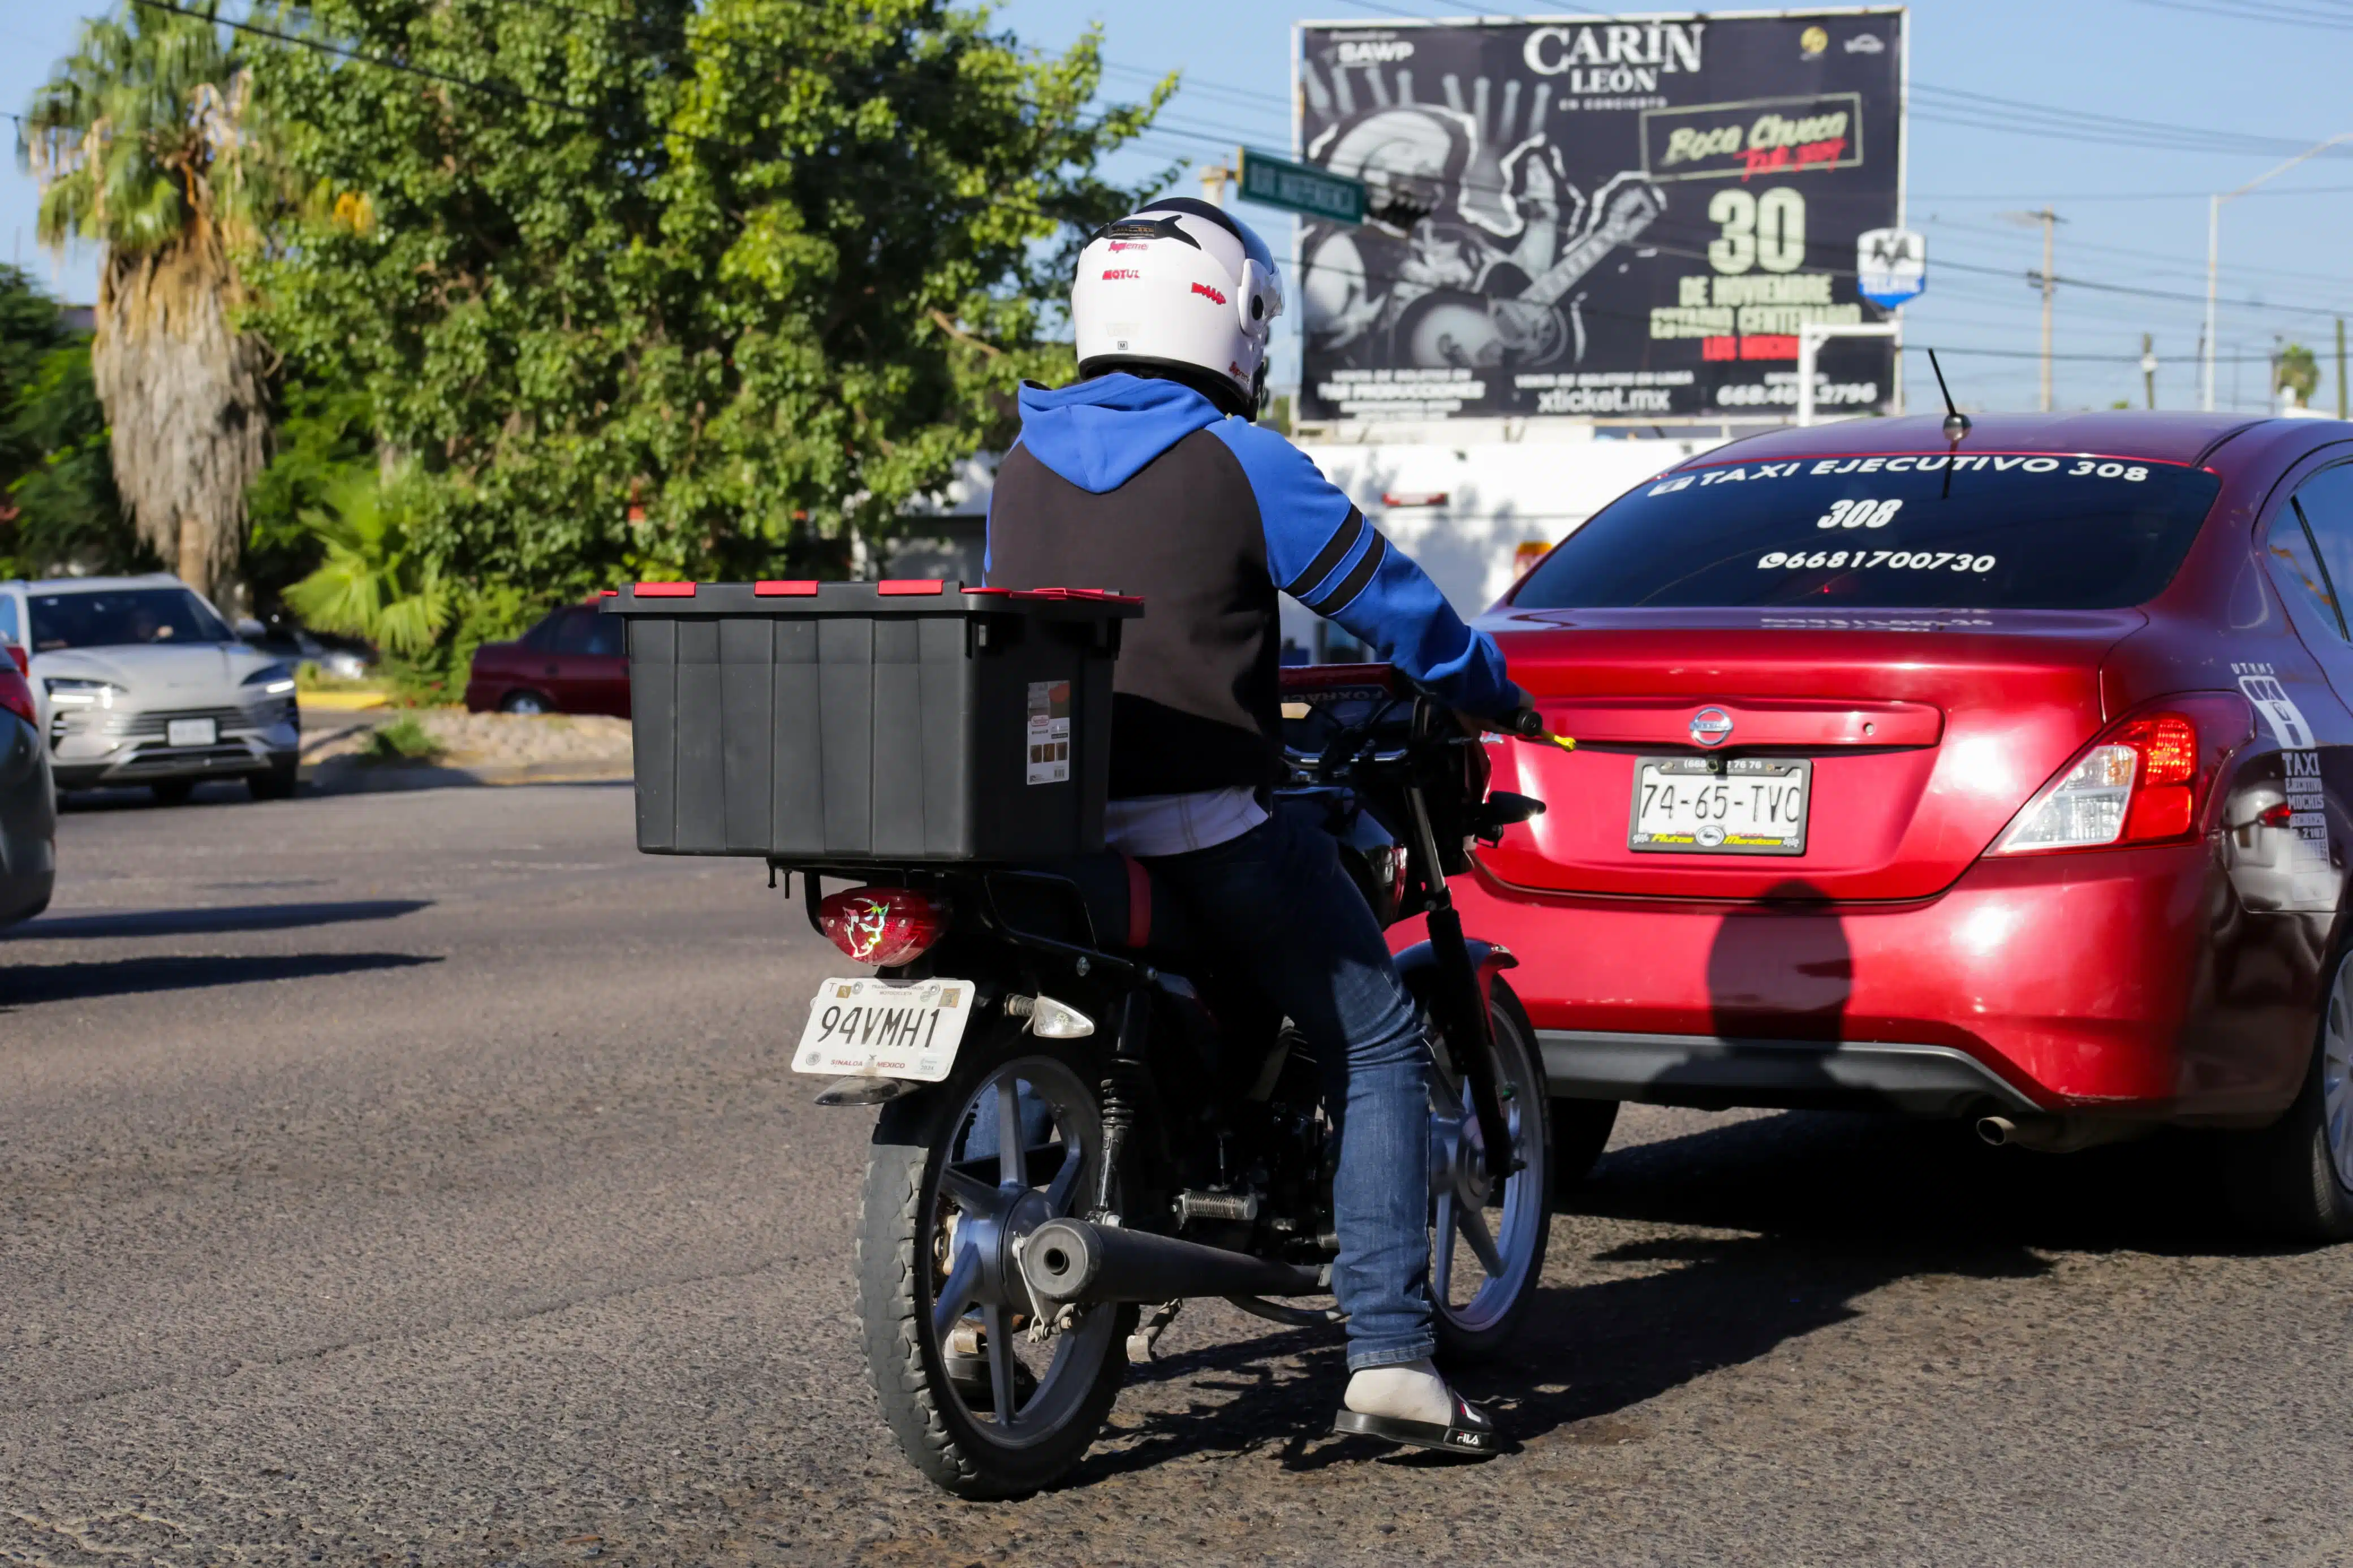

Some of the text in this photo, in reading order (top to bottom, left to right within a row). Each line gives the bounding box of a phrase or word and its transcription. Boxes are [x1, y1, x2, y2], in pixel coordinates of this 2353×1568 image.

[1523, 20, 1705, 75] CARÍN
[1570, 62, 1657, 94] LEÓN
[1708, 187, 1805, 275] 30
[1537, 387, 1671, 413] xticket.mx
[1700, 457, 2149, 487] TAXI EJECUTIVO 308
[1817, 499, 1903, 529] 308
[1785, 552, 1996, 572] 6681700730
[2282, 752, 2321, 776] TAXI
[817, 1005, 941, 1048] 94VMH1
[830, 1059, 906, 1069] SINALOA MEXICO
[1456, 1431, 1480, 1445] FILA
